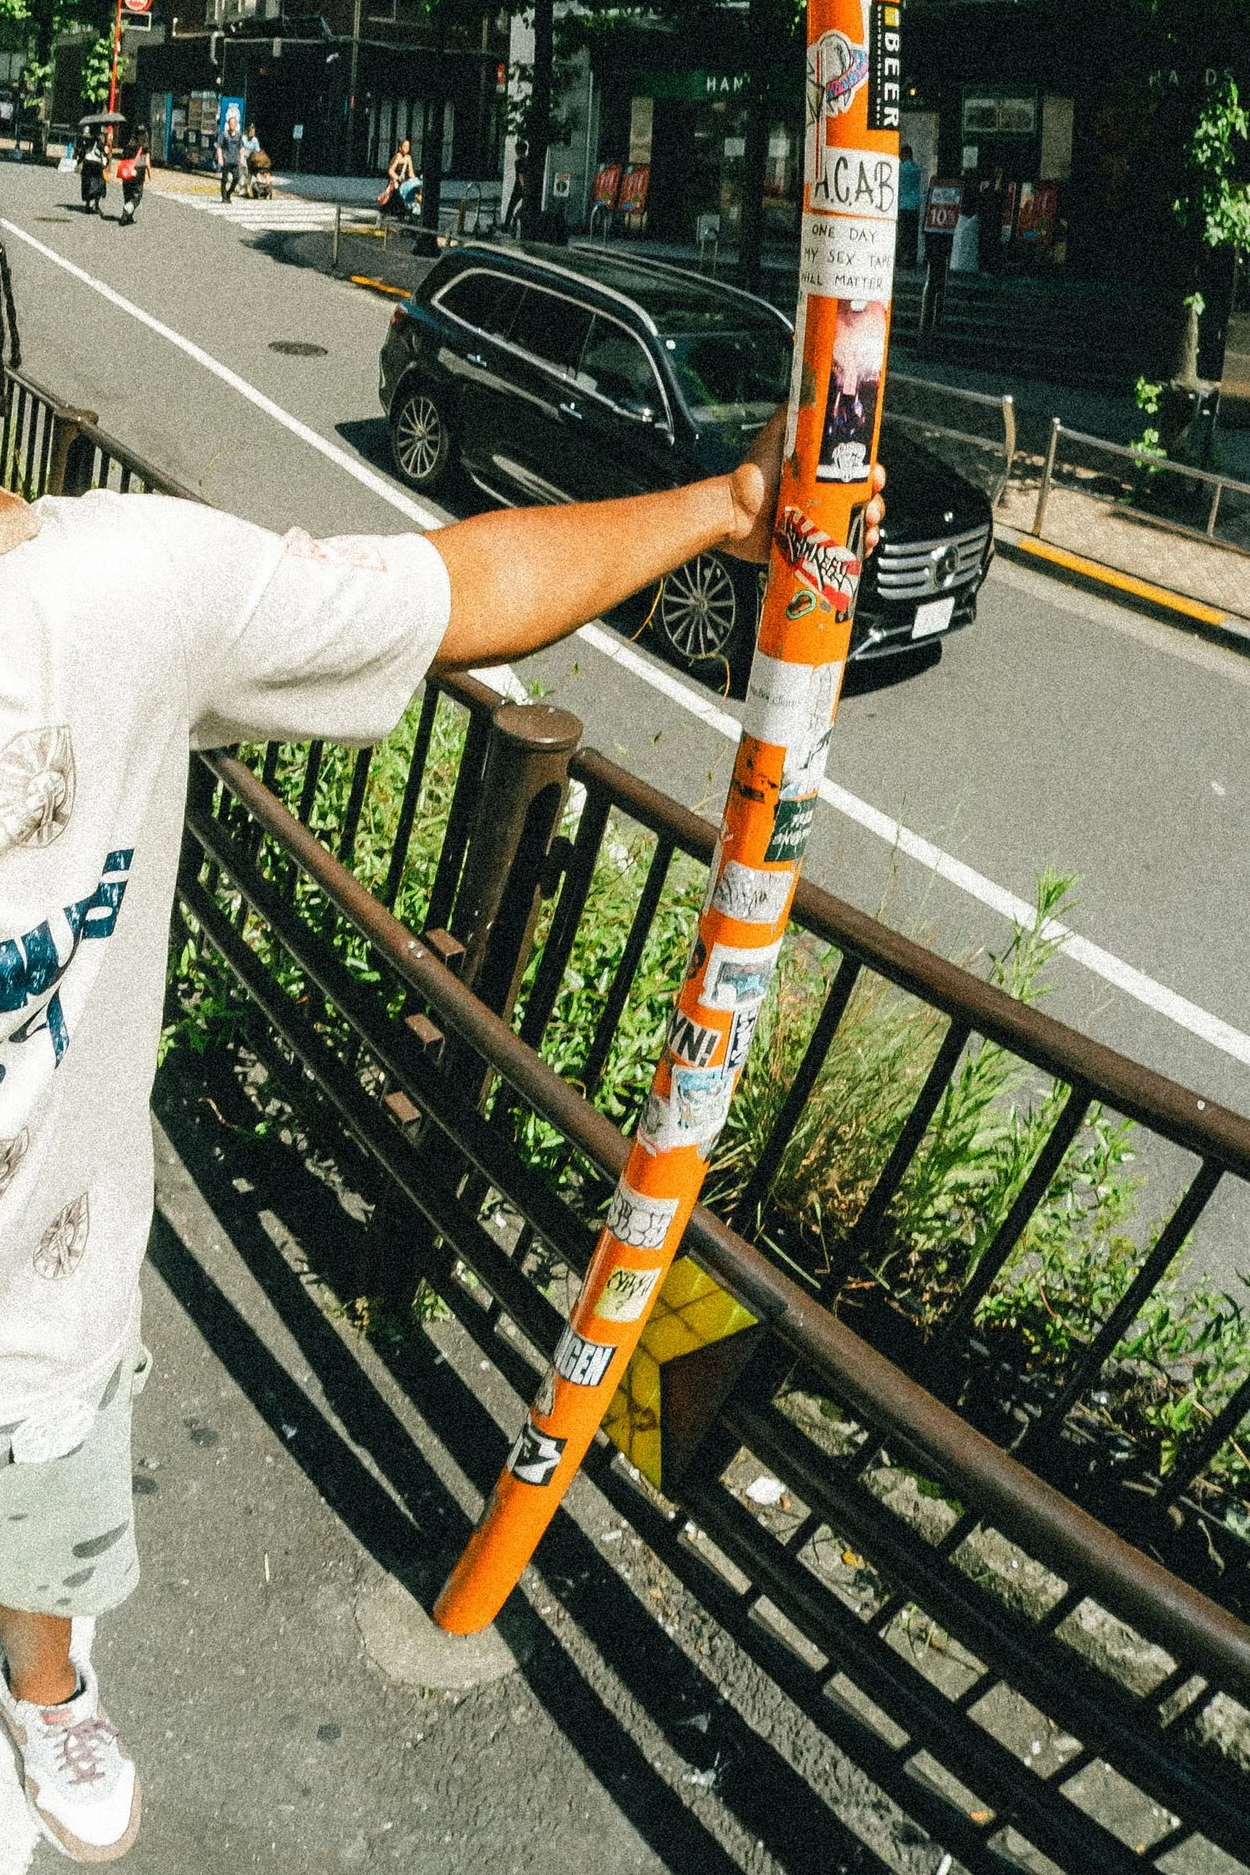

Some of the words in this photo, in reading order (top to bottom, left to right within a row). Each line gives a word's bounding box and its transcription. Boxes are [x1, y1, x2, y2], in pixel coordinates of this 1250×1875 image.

[884, 32, 900, 127] BEER
[1148, 66, 1235, 86] HADS
[811, 224, 835, 239] ONE
[849, 227, 877, 243] DAY
[803, 248, 819, 263] MY
[827, 249, 856, 266] SEX
[835, 275, 884, 291] MATTER
